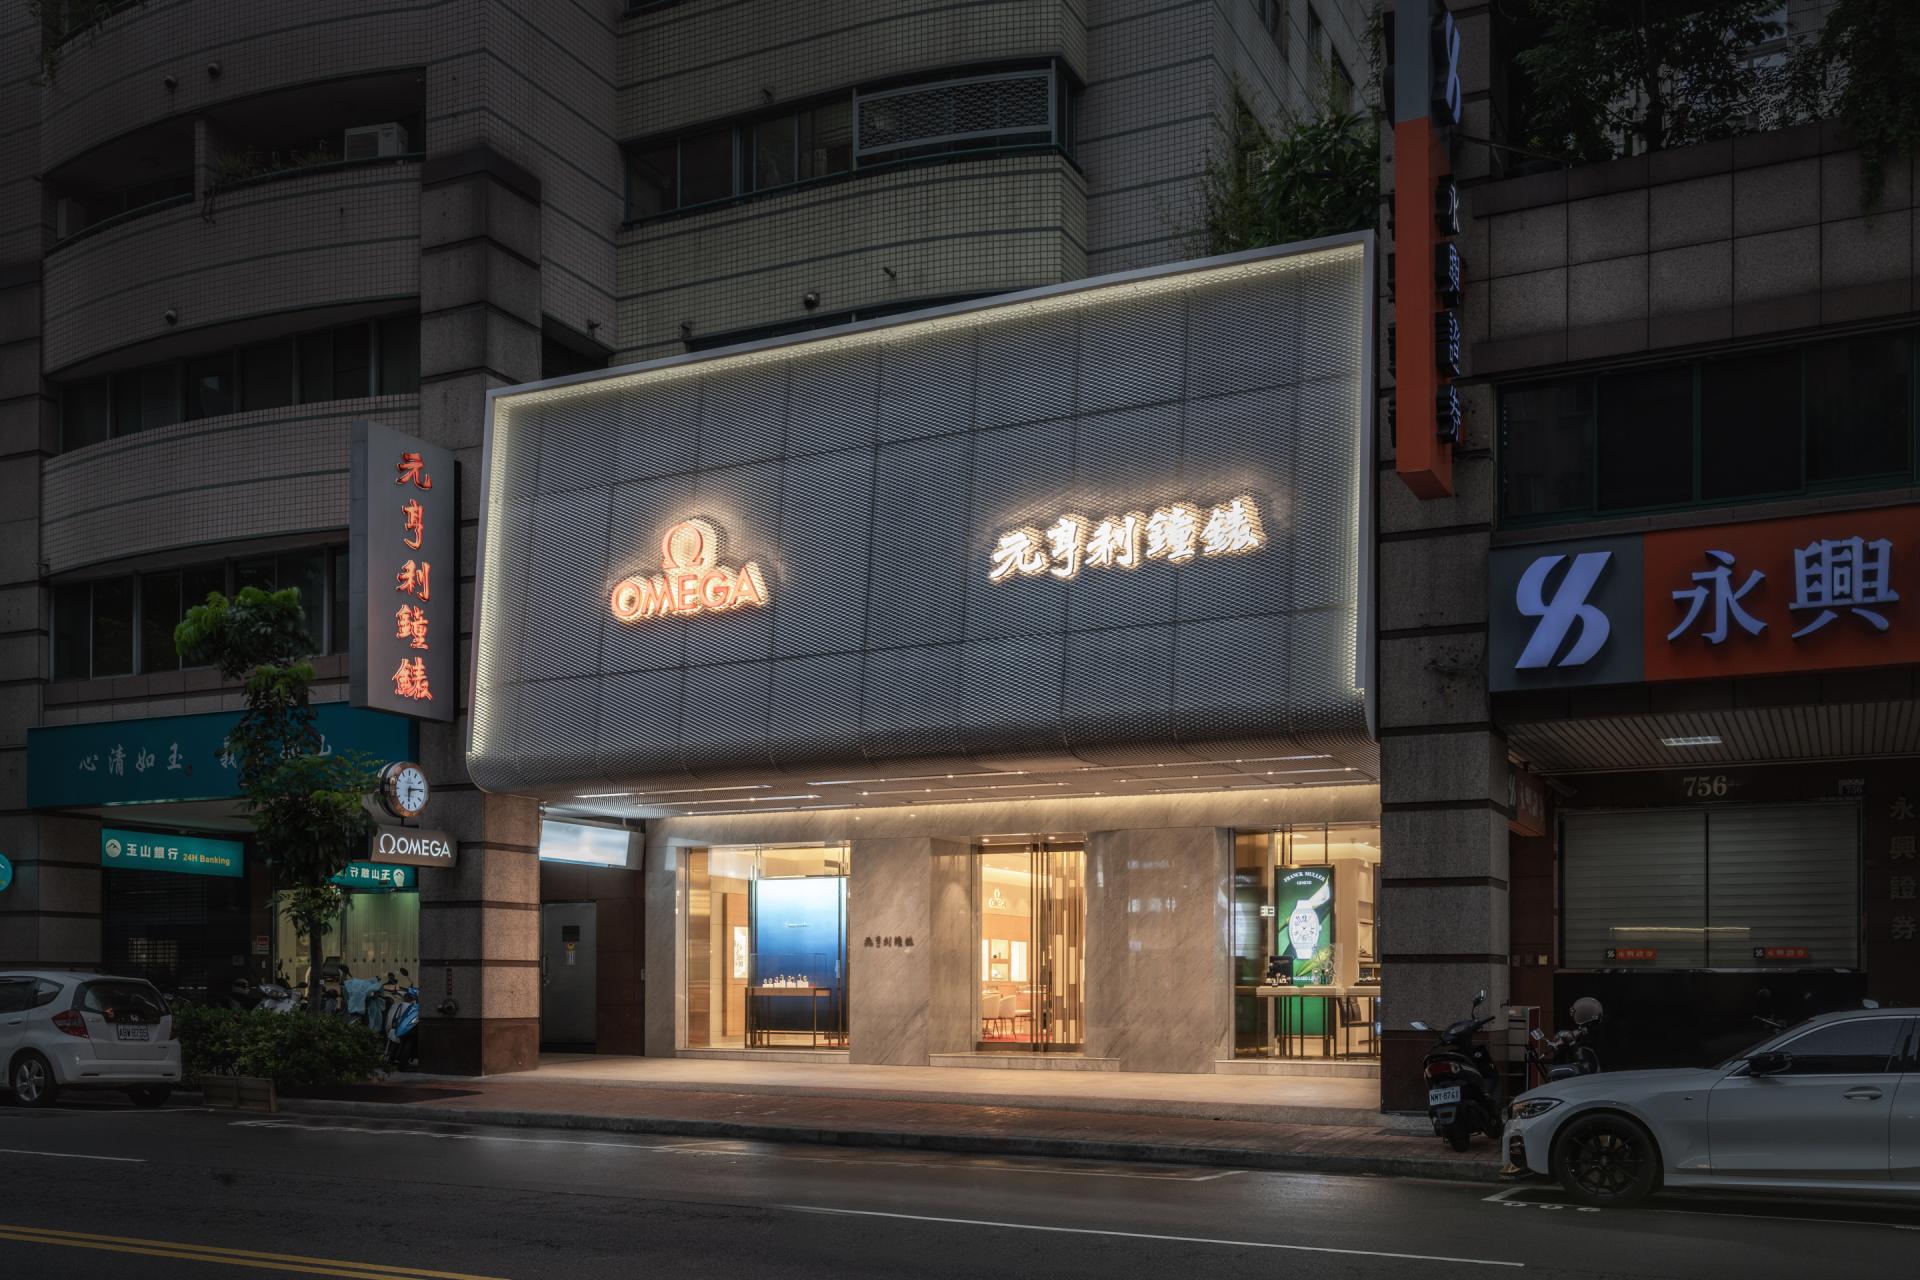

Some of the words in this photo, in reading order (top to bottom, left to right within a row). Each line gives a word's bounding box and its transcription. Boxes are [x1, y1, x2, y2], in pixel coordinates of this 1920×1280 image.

[611, 565, 763, 608] OMEGA
[1667, 536, 1900, 645] 永興
[78, 743, 184, 776] 心清如玉
[1683, 775, 1727, 797] 756
[126, 843, 179, 860] 玉山銀行
[183, 853, 198, 863] 24H
[200, 854, 232, 867] Banking
[1889, 796, 1917, 940] 永興證券
